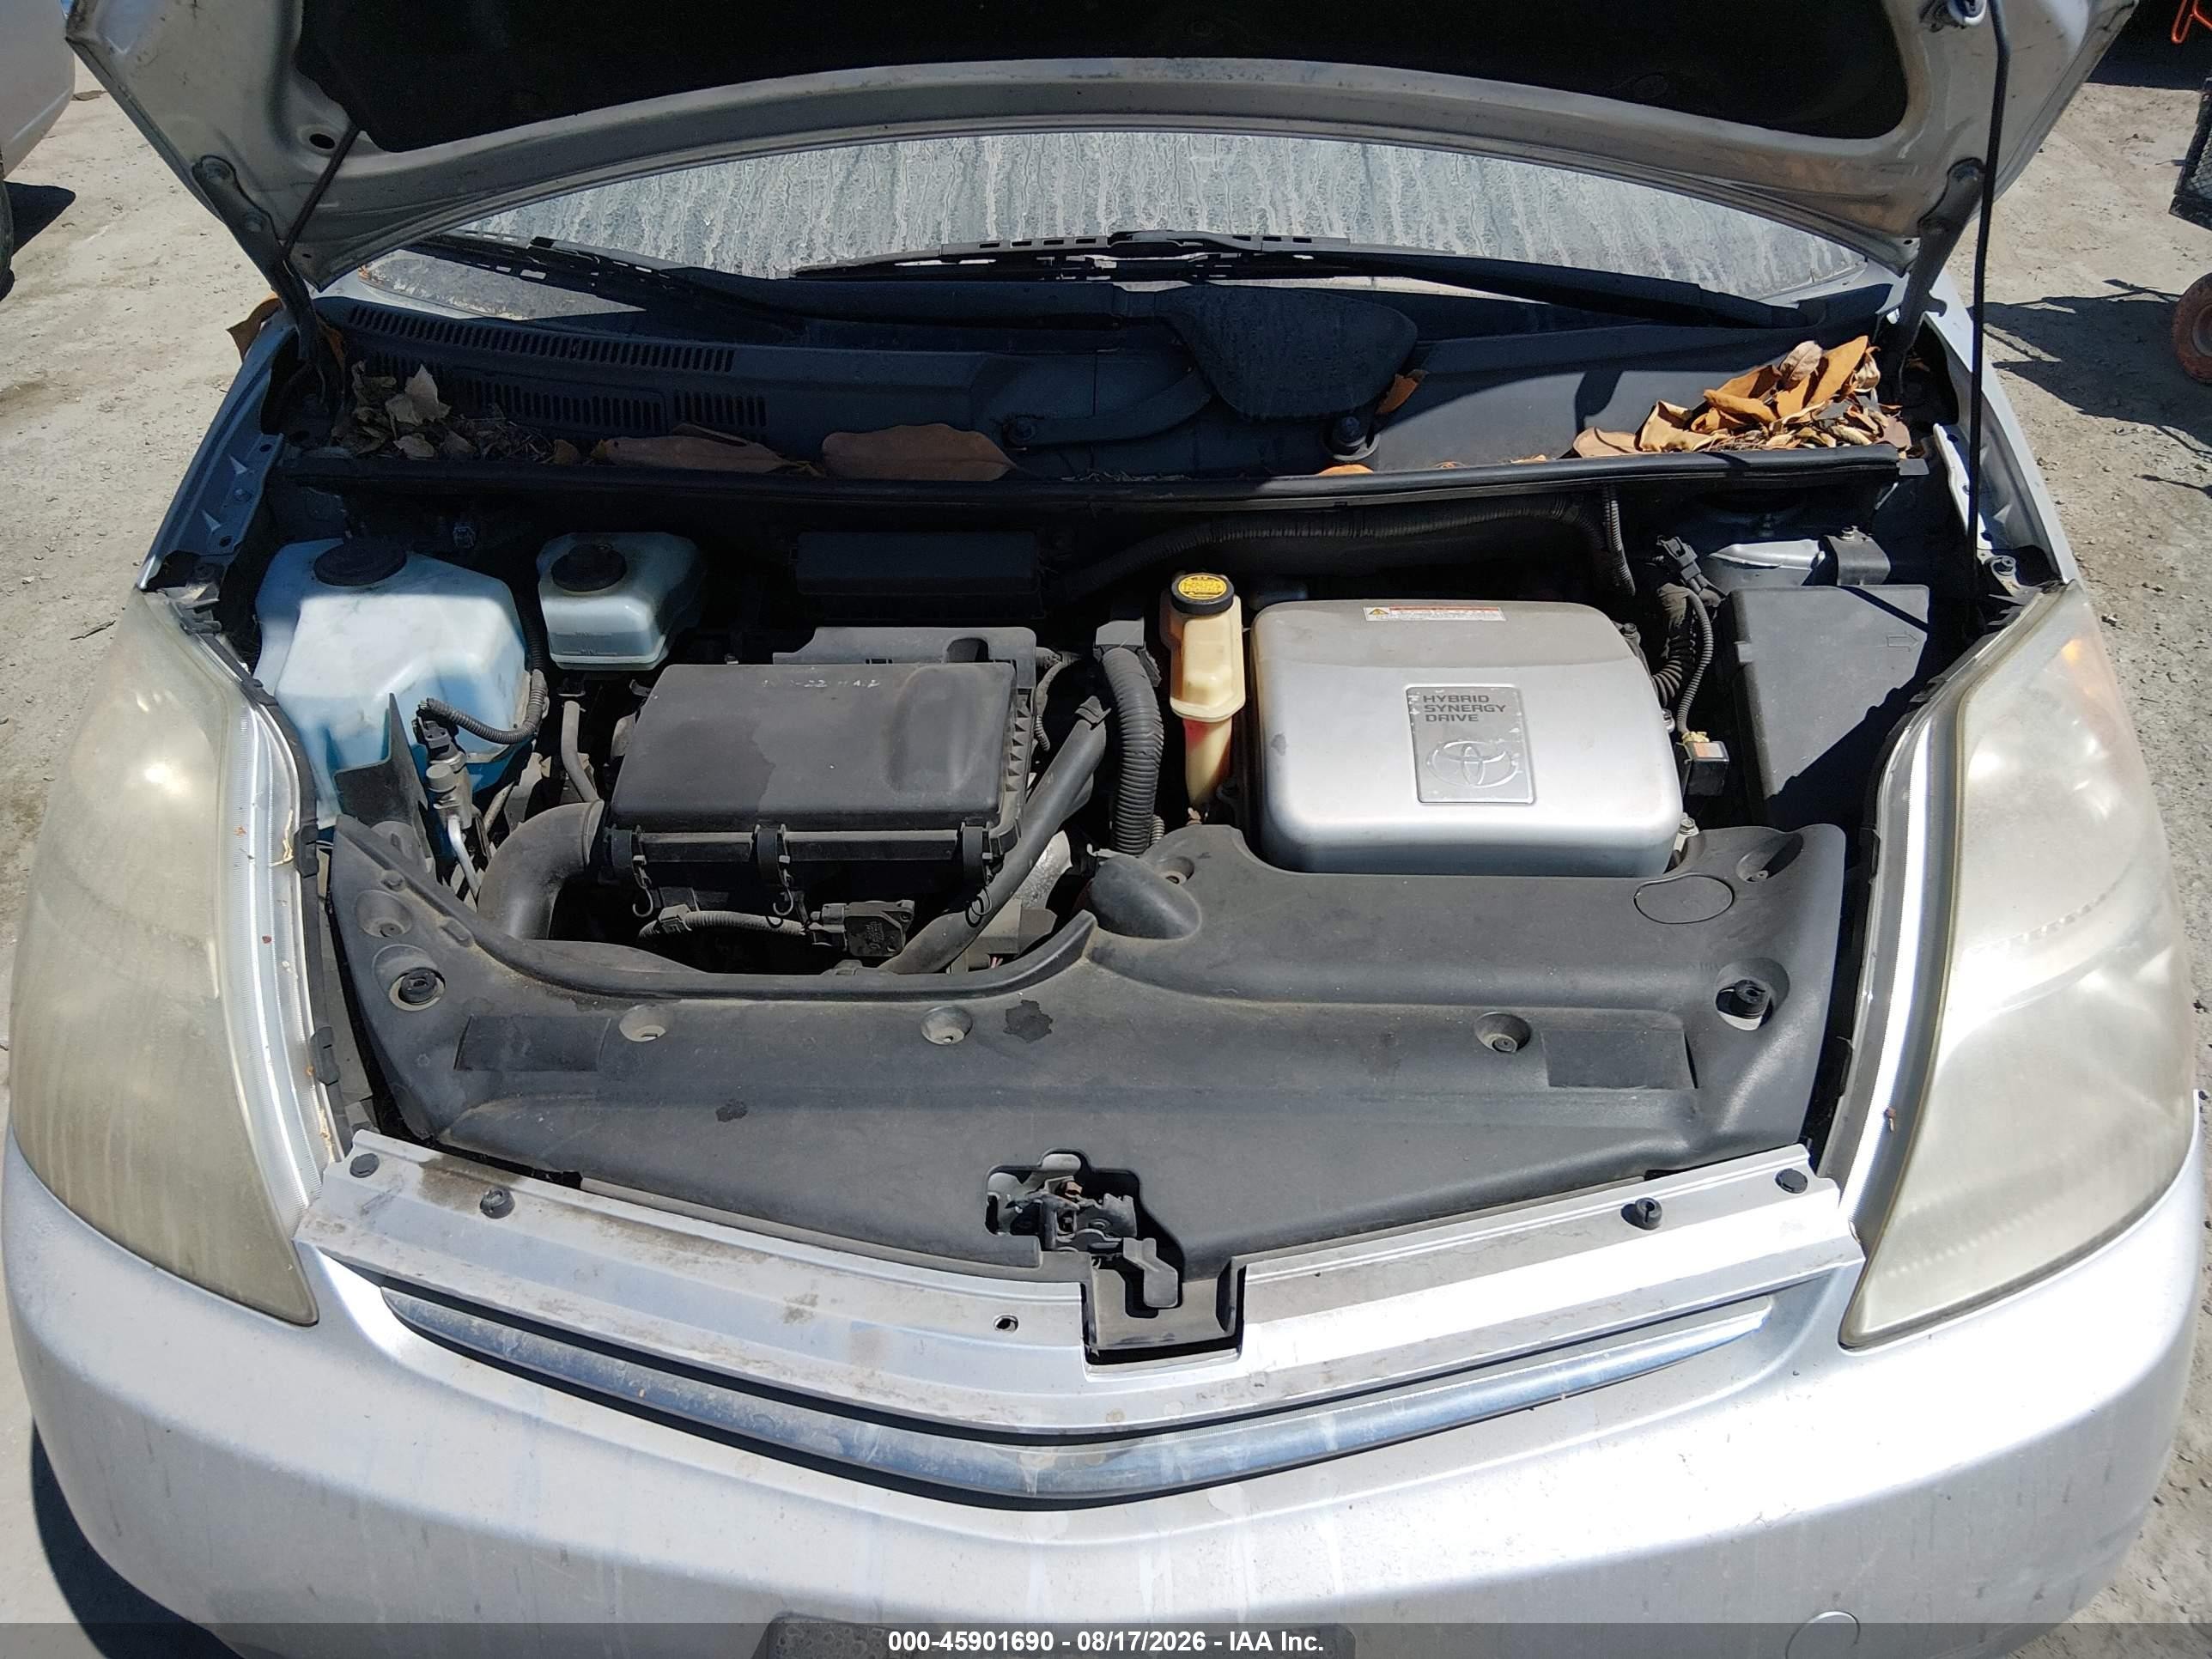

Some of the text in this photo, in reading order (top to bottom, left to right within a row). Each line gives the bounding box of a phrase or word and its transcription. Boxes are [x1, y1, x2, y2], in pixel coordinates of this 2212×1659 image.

[1423, 695, 1490, 703] HYBRID
[1424, 704, 1506, 713] SYNERGY
[1425, 714, 1479, 722] DRIVE
